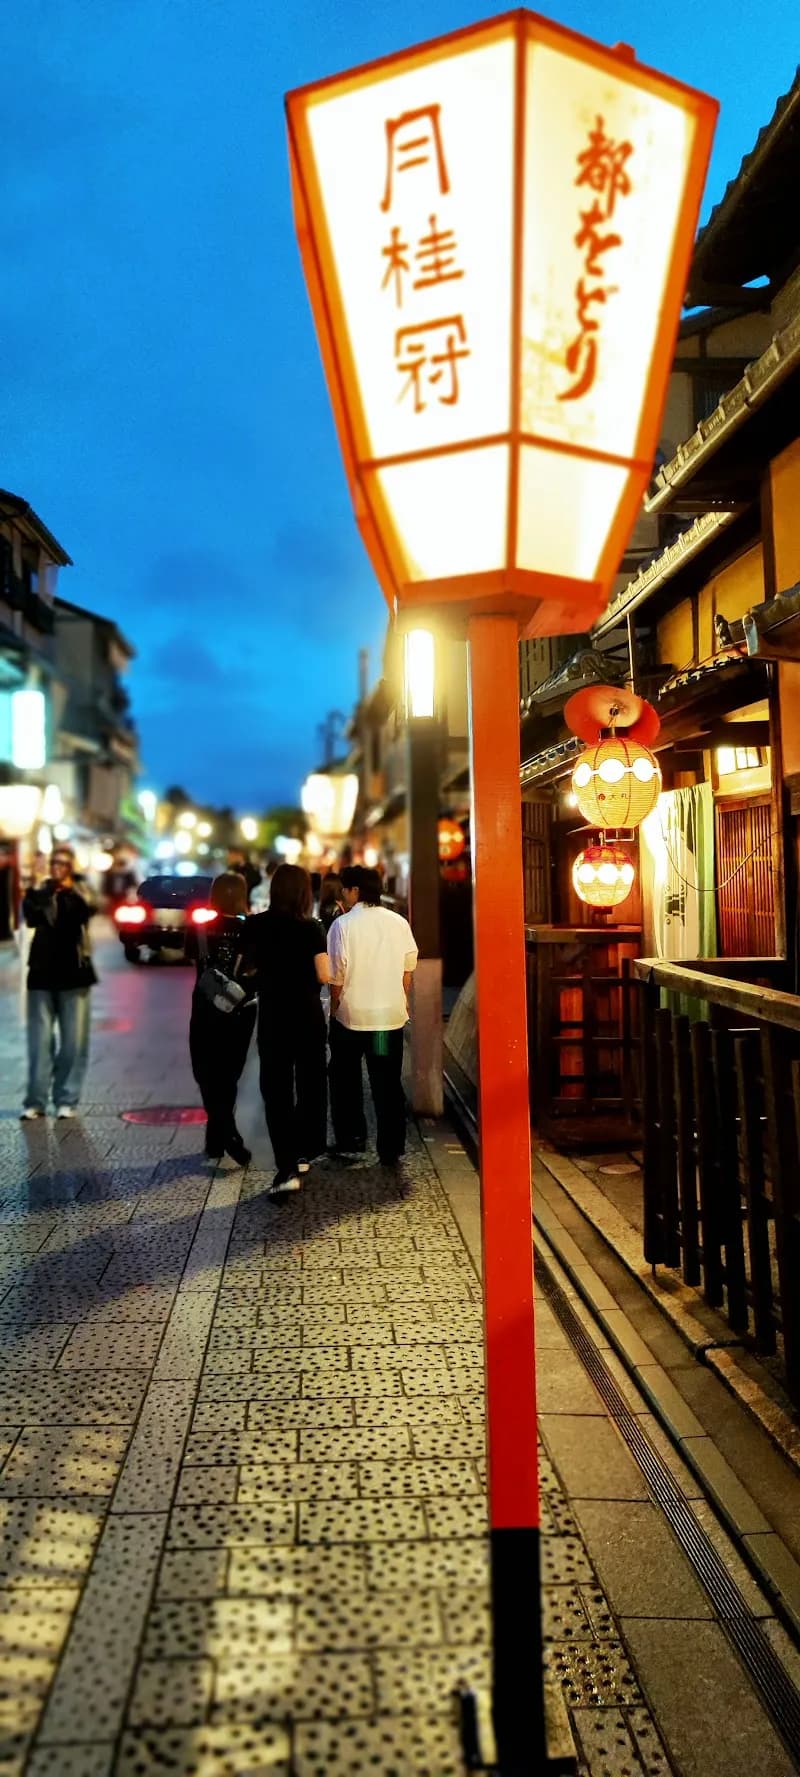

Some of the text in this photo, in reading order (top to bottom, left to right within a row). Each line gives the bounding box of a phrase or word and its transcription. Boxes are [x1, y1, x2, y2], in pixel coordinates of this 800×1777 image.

[380, 103, 471, 413] 月桂冠
[558, 115, 634, 401] 都をどり
